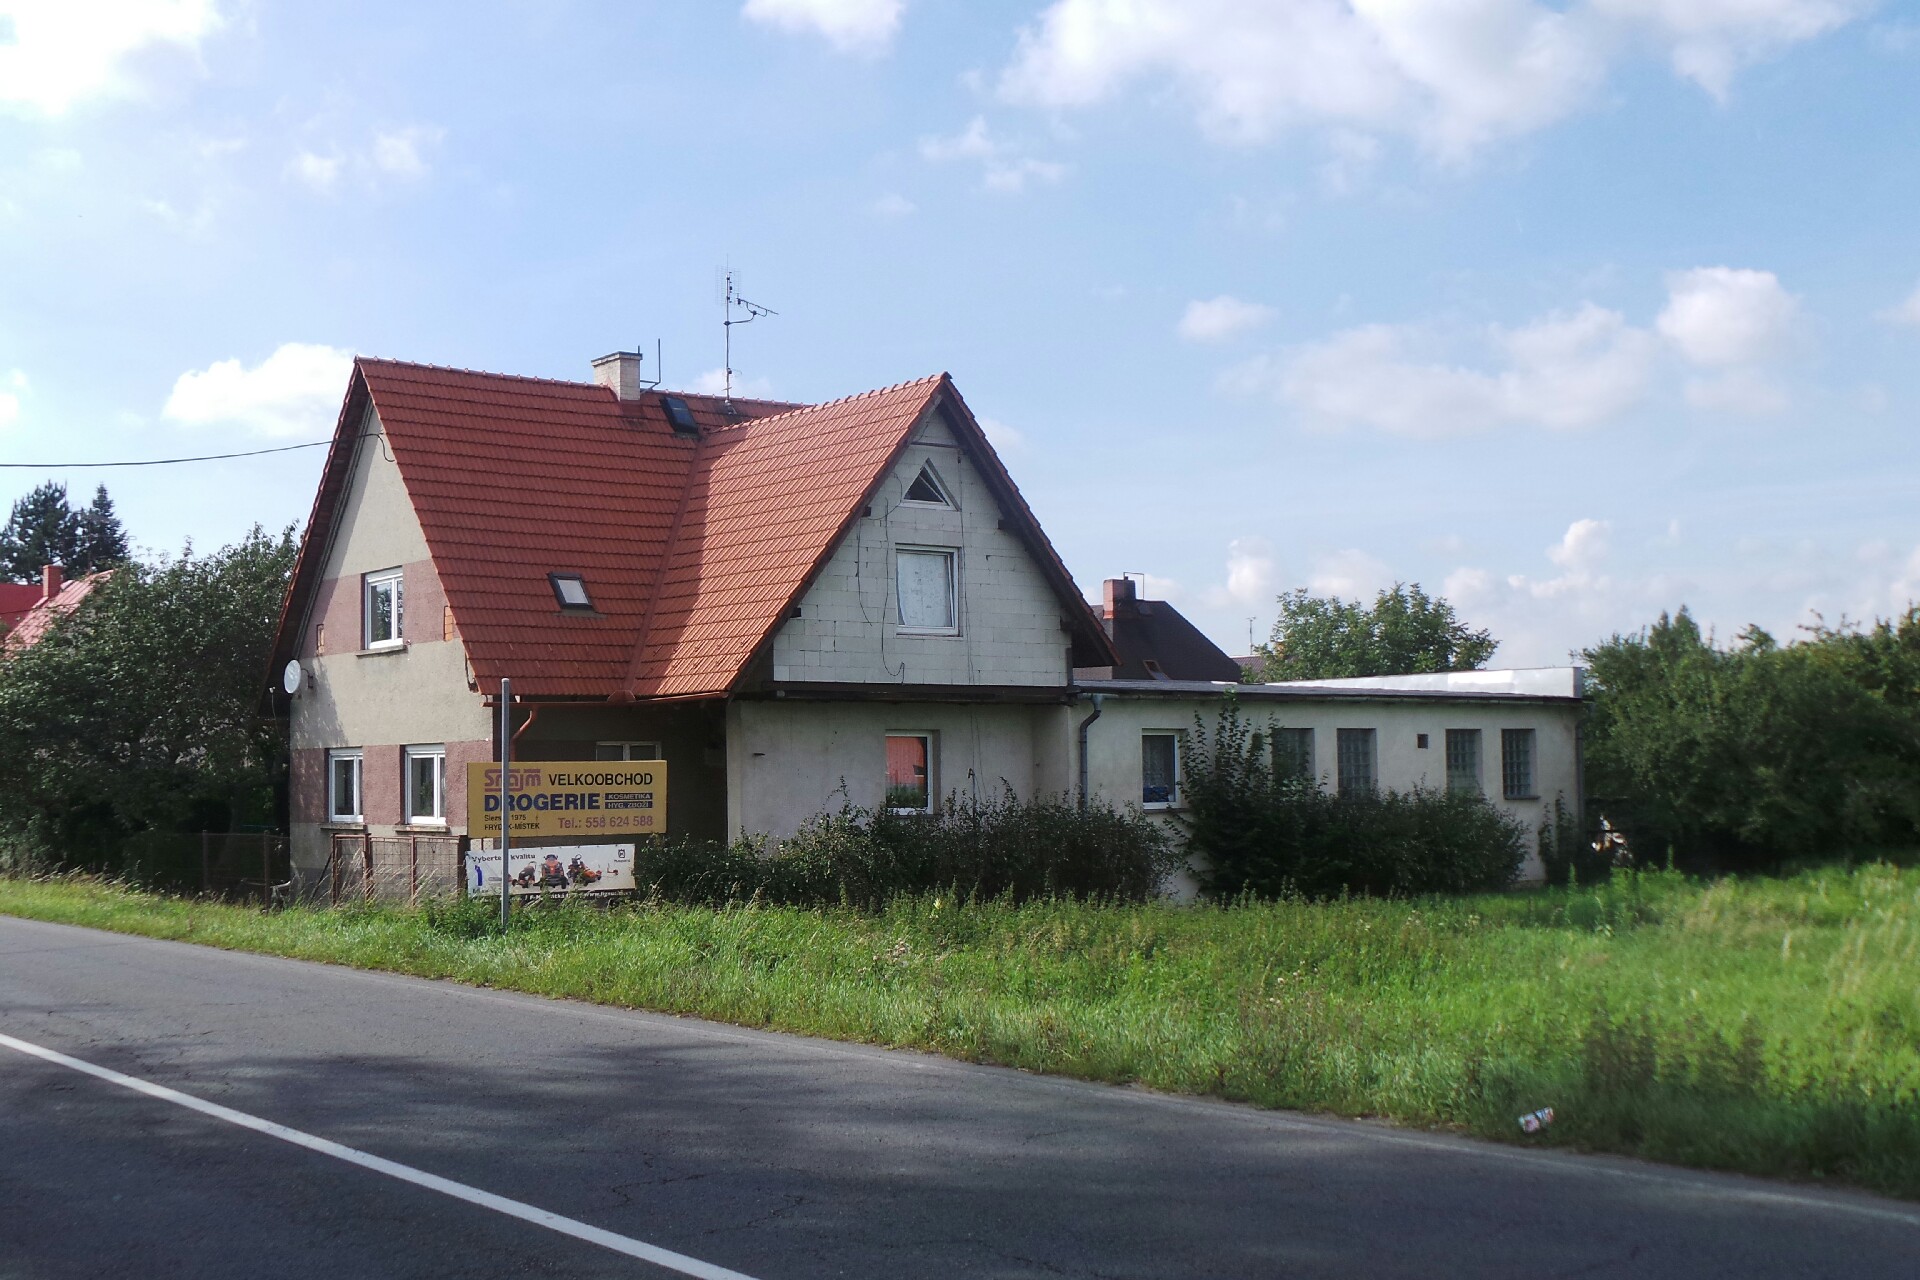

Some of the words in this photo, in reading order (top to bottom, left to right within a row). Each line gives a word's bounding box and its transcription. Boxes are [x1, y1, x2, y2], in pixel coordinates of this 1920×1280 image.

[549, 773, 653, 786] VELKOOBCHOD
[484, 793, 600, 812] DROGERIE
[484, 821, 540, 831] FRÝDK-MÍSTEK
[585, 816, 606, 828] 558
[609, 816, 629, 828] 624
[632, 815, 653, 827] 588
